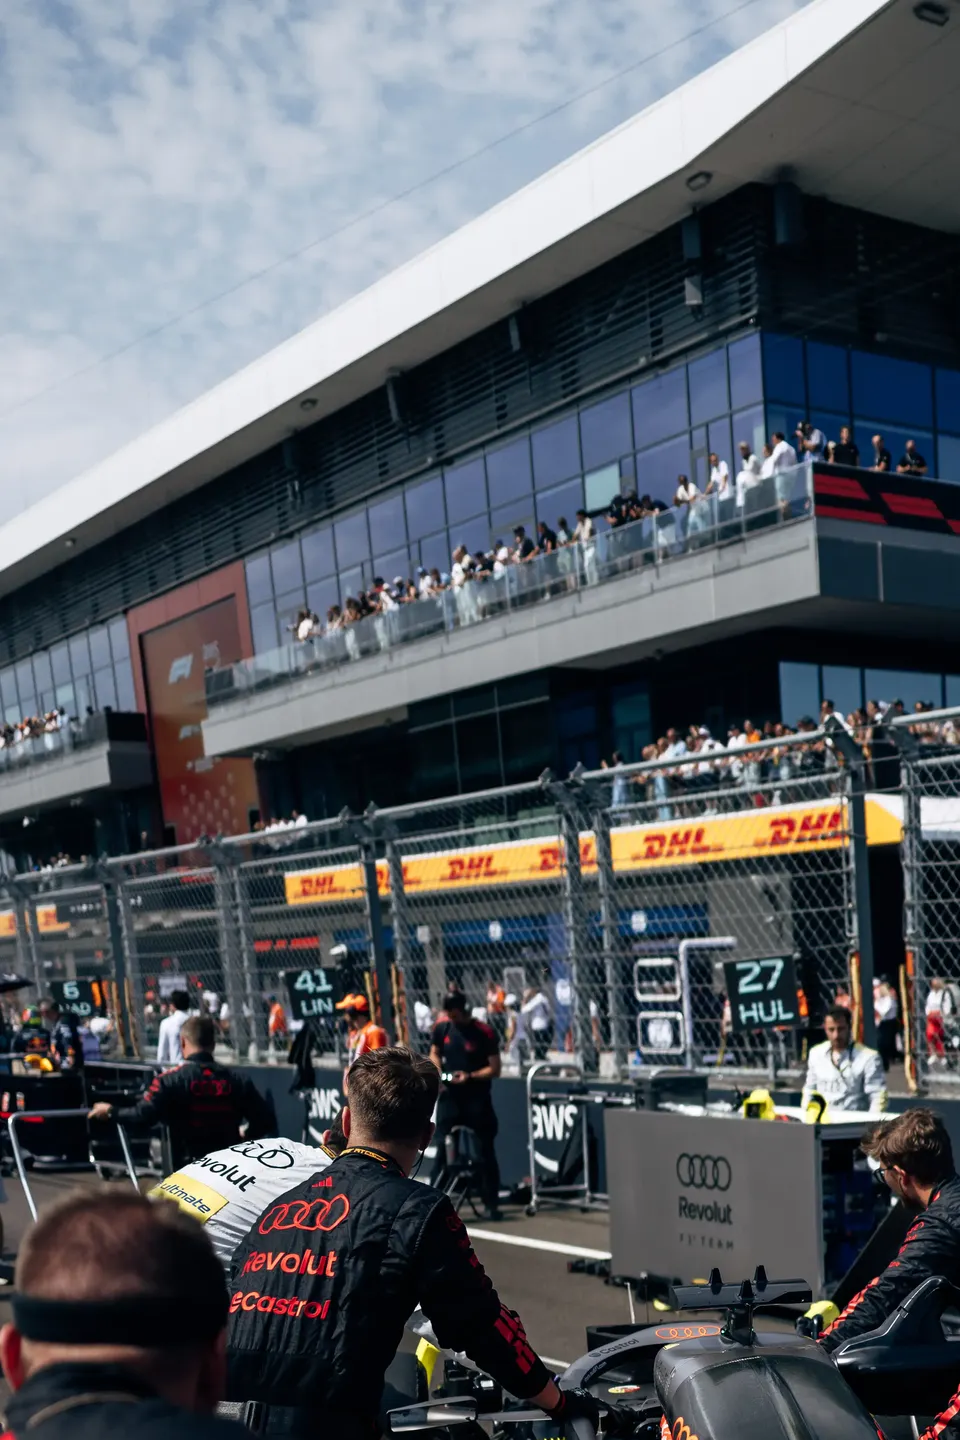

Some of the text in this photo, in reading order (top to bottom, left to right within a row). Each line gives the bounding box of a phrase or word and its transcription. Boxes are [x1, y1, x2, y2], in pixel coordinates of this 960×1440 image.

[641, 826, 712, 861] DHL
[446, 854, 496, 880] DHL
[298, 873, 339, 897] DHL
[293, 968, 333, 994] 41
[735, 957, 784, 994] 27
[301, 997, 334, 1017] LIN
[738, 999, 794, 1024] HUL
[192, 1156, 257, 1193] evolut
[160, 1180, 211, 1215] ultimate
[679, 1195, 733, 1226] Revolut
[240, 1248, 338, 1278] Revolut
[600, 1338, 640, 1355] Castrol
